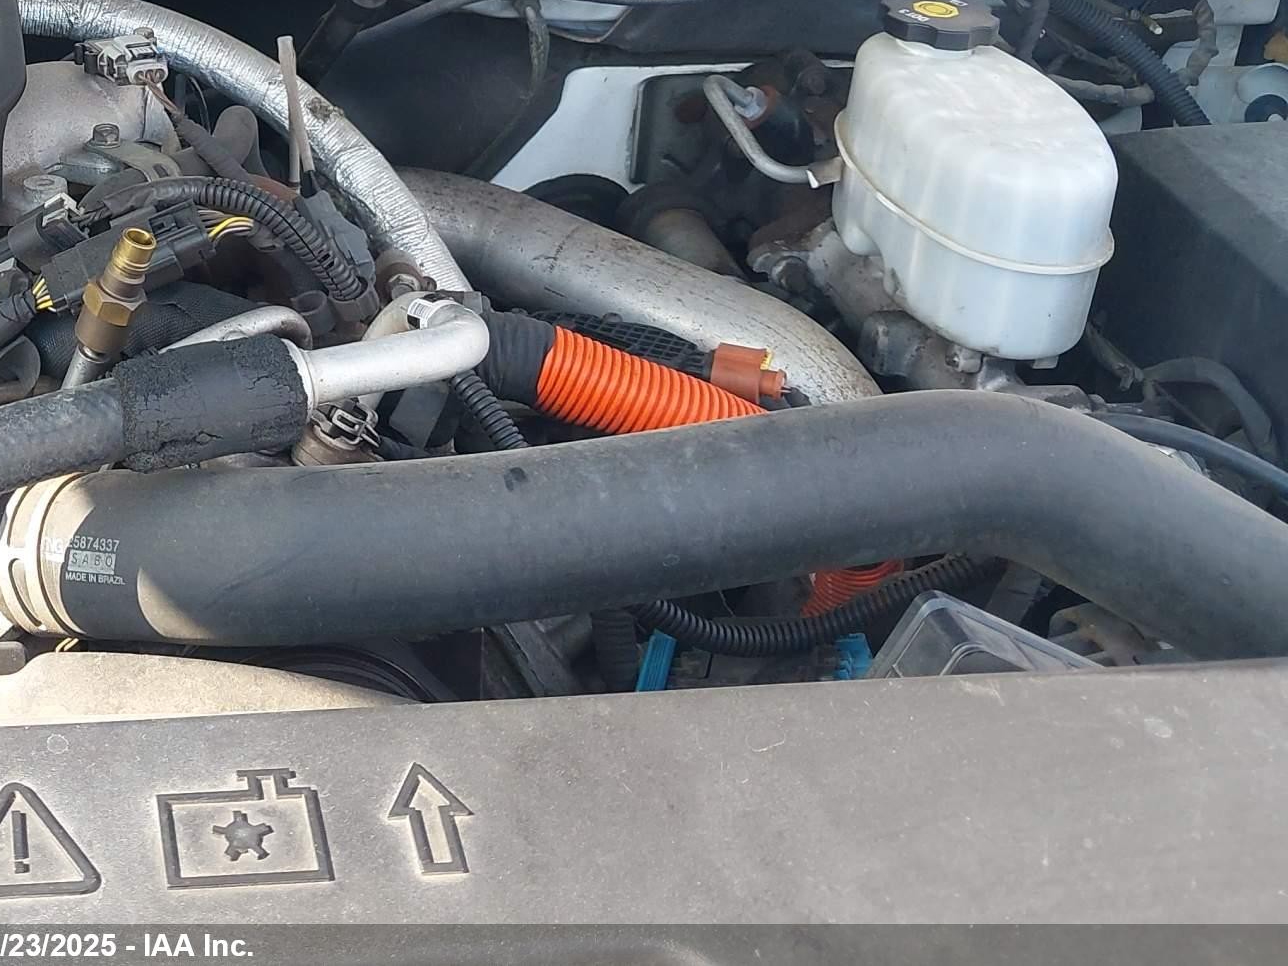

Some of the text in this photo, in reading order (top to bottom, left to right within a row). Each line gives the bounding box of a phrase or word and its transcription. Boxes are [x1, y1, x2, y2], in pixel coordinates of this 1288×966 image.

[65, 571, 126, 586] MADE IN BRAZIL
